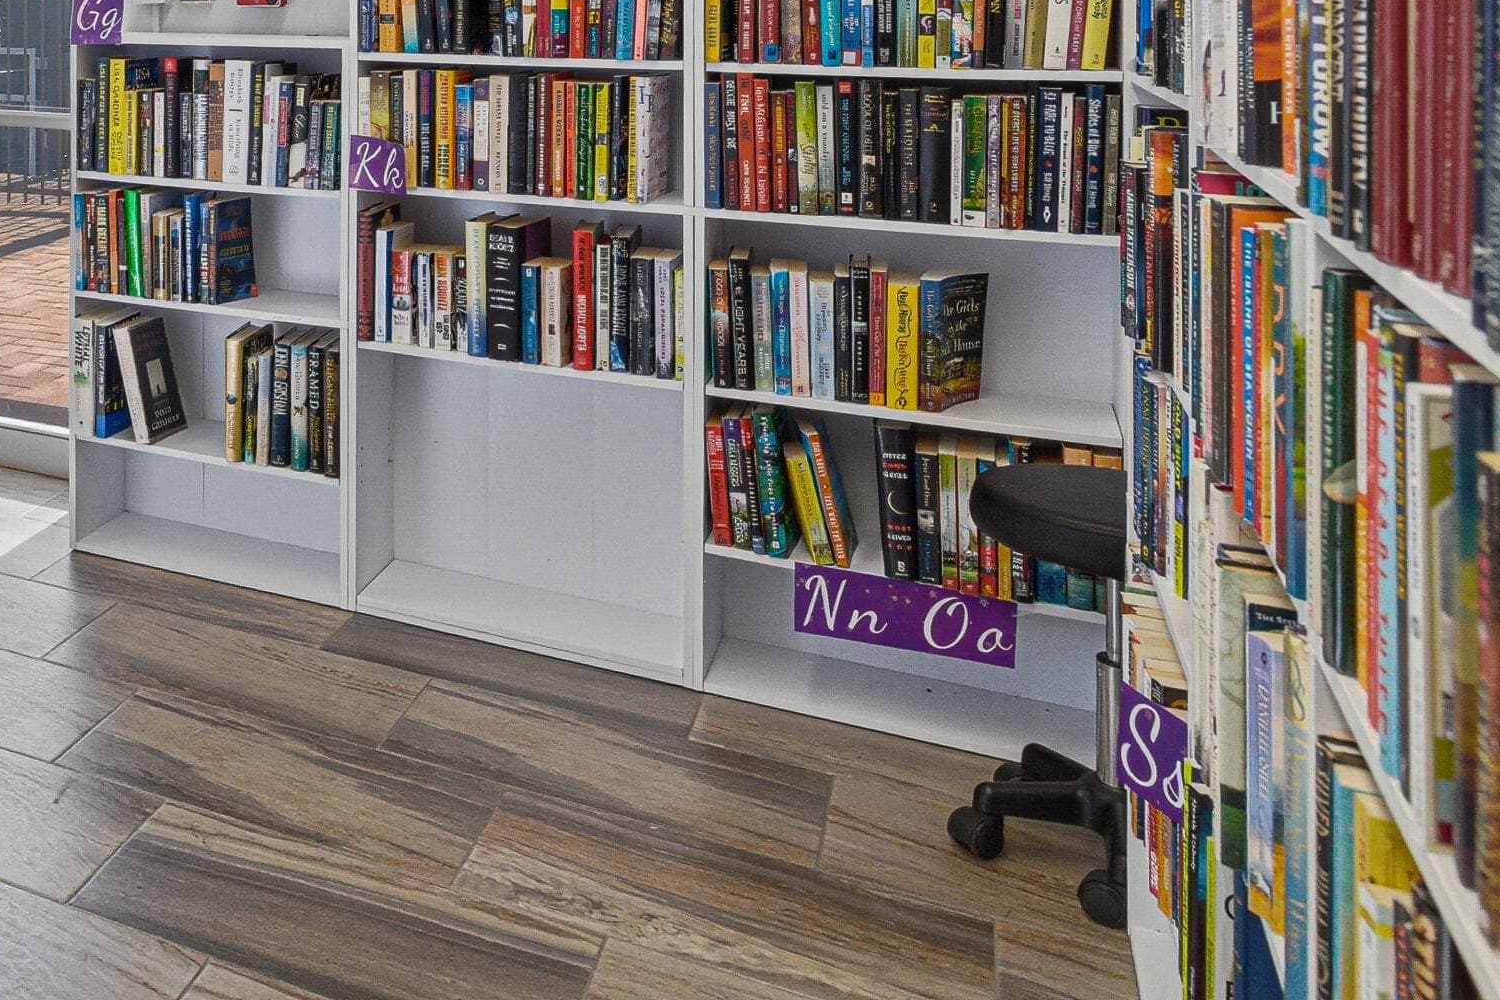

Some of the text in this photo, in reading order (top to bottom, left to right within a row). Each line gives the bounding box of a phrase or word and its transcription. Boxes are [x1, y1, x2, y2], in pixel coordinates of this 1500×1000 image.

[1311, 42, 1329, 158] TUROW
[355, 141, 405, 190] Kk
[1126, 228, 1135, 288] PATTERSON
[74, 331, 83, 367] WHITE
[82, 326, 91, 361] LETHAL
[734, 299, 746, 375] LIGHT YEARS
[1243, 241, 1253, 460] THE ISLAND OF SEA WOMEN
[274, 380, 287, 415] GRISHAM
[307, 352, 319, 410] FRAMED
[1324, 311, 1334, 468] DEADLY SLIPPER
[803, 574, 888, 635] Nn
[1257, 684, 1270, 801] DANIELLE STEEL
